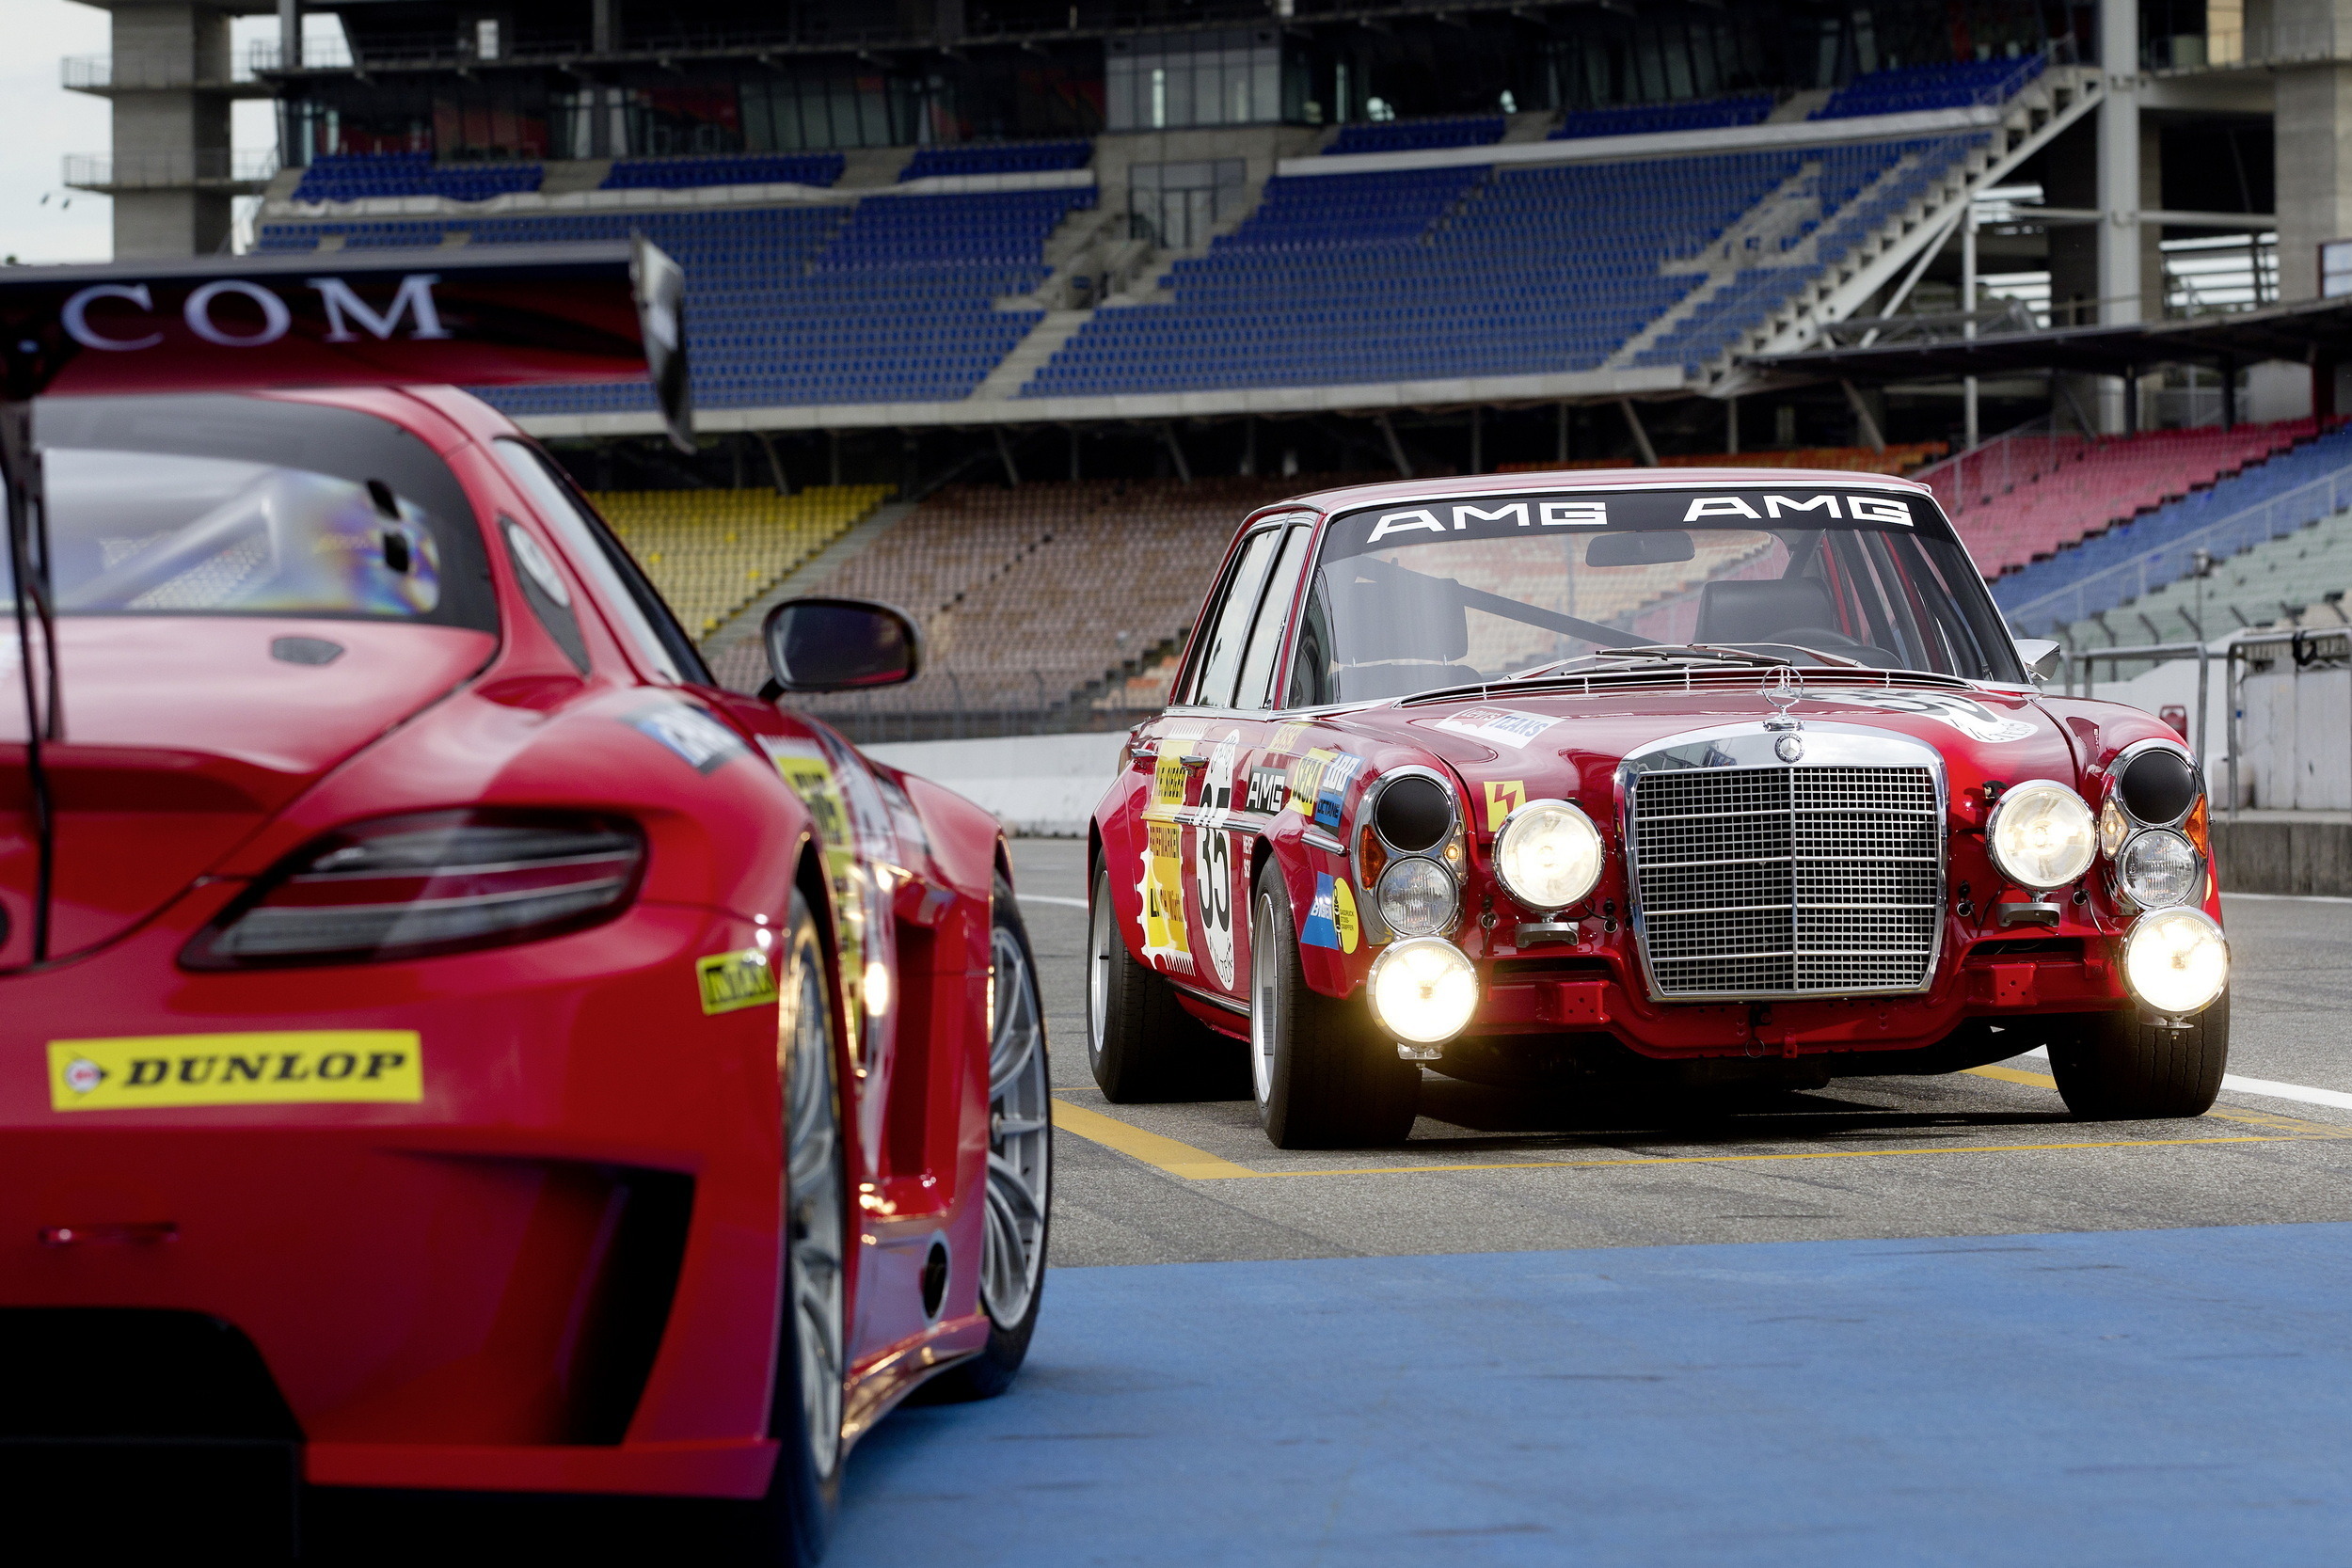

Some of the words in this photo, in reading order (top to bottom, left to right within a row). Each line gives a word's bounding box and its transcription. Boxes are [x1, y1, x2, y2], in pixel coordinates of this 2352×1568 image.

[1367, 501, 1607, 543] AMG
[1683, 495, 1914, 527] AMG
[1489, 716, 1549, 736] JEANS
[1247, 772, 1285, 812] AMG
[1317, 799, 1340, 818] OCTANE
[1197, 783, 1231, 932] 35
[122, 1051, 406, 1087] DUNLOP
